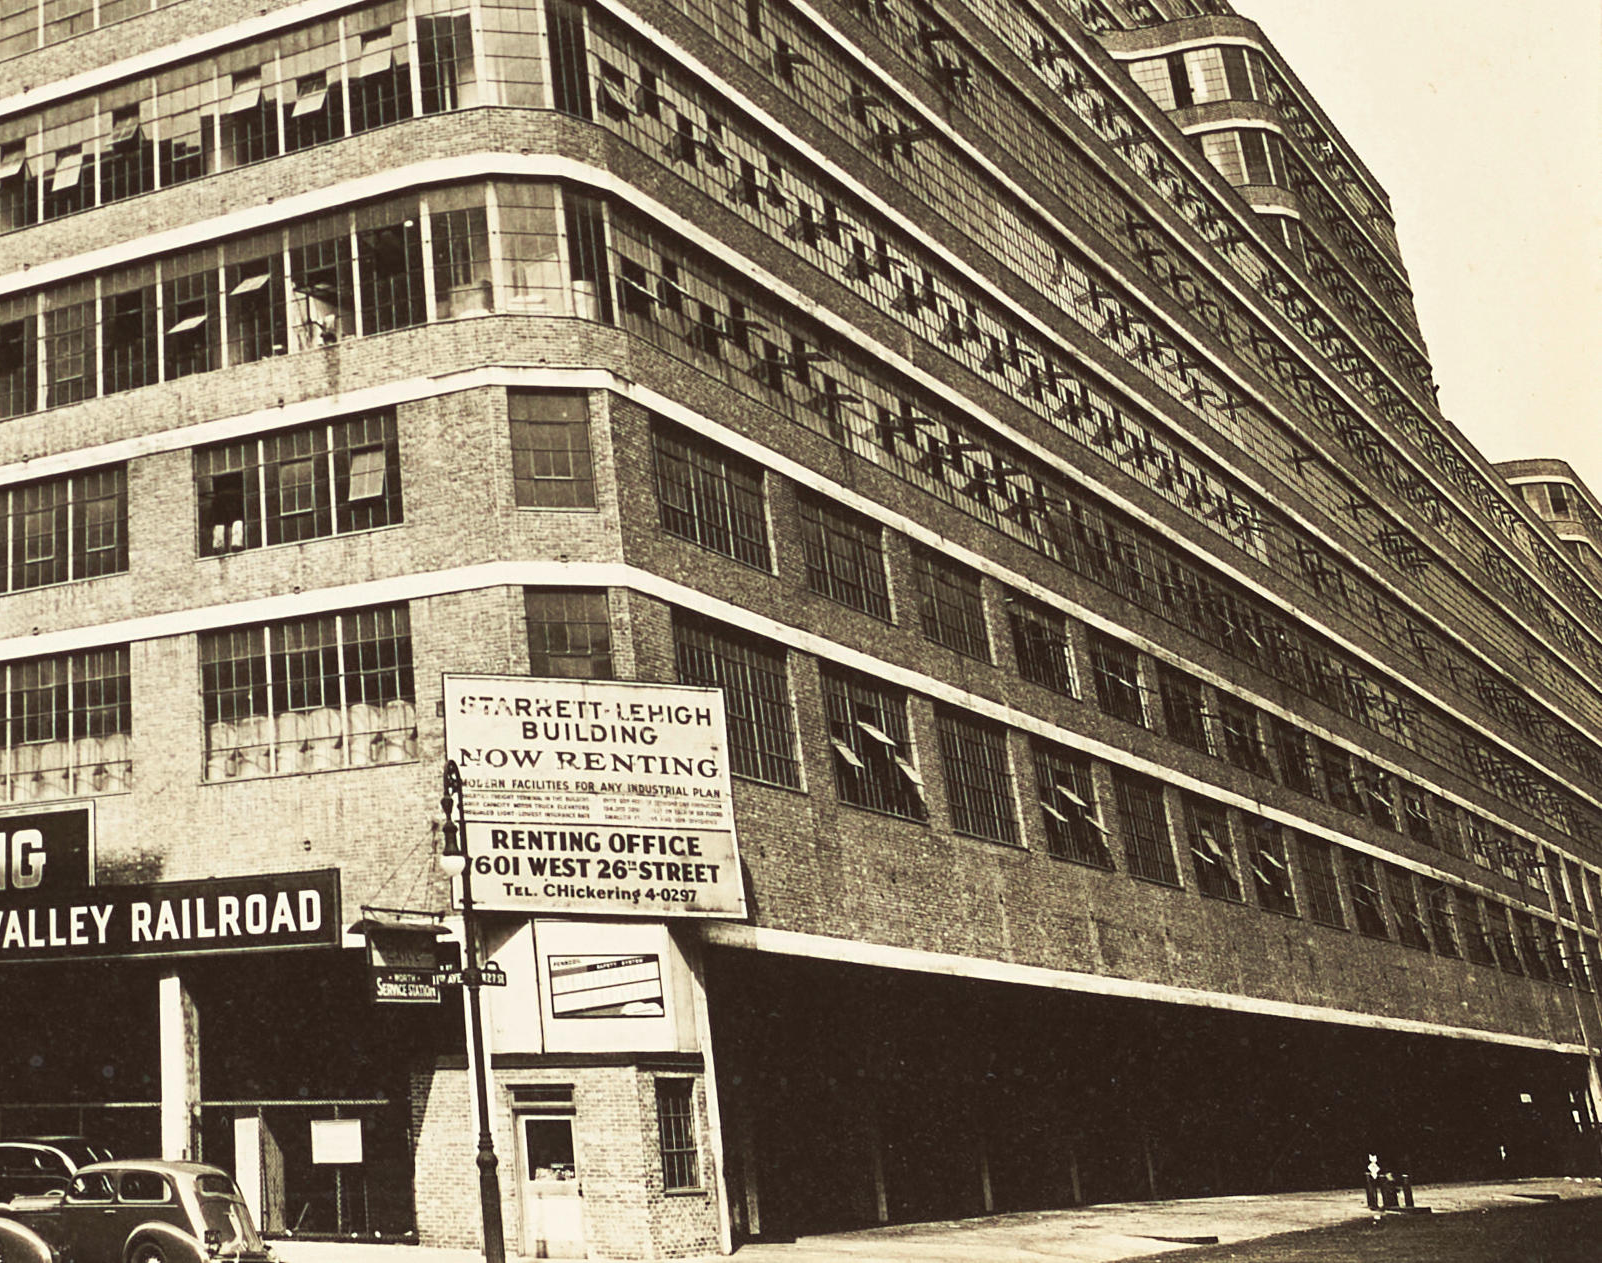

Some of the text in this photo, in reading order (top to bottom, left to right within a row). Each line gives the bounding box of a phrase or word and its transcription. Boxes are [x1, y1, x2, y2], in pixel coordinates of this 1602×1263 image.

[522, 721, 658, 745] BUILDING
[460, 748, 718, 778] NOW RENTING
[512, 779, 569, 790] FACILITIES
[575, 781, 595, 791] FOR
[600, 782, 622, 792] ANY
[627, 783, 688, 796] INDUSTRIAL
[693, 788, 720, 798] PLAN
[491, 829, 702, 857] RENTING OFFICE
[475, 855, 720, 884] 601 WEST 26TH STREET
[502, 882, 538, 897] TEL.
[543, 883, 641, 904] CHickering
[131, 889, 321, 942] RAILROAD
